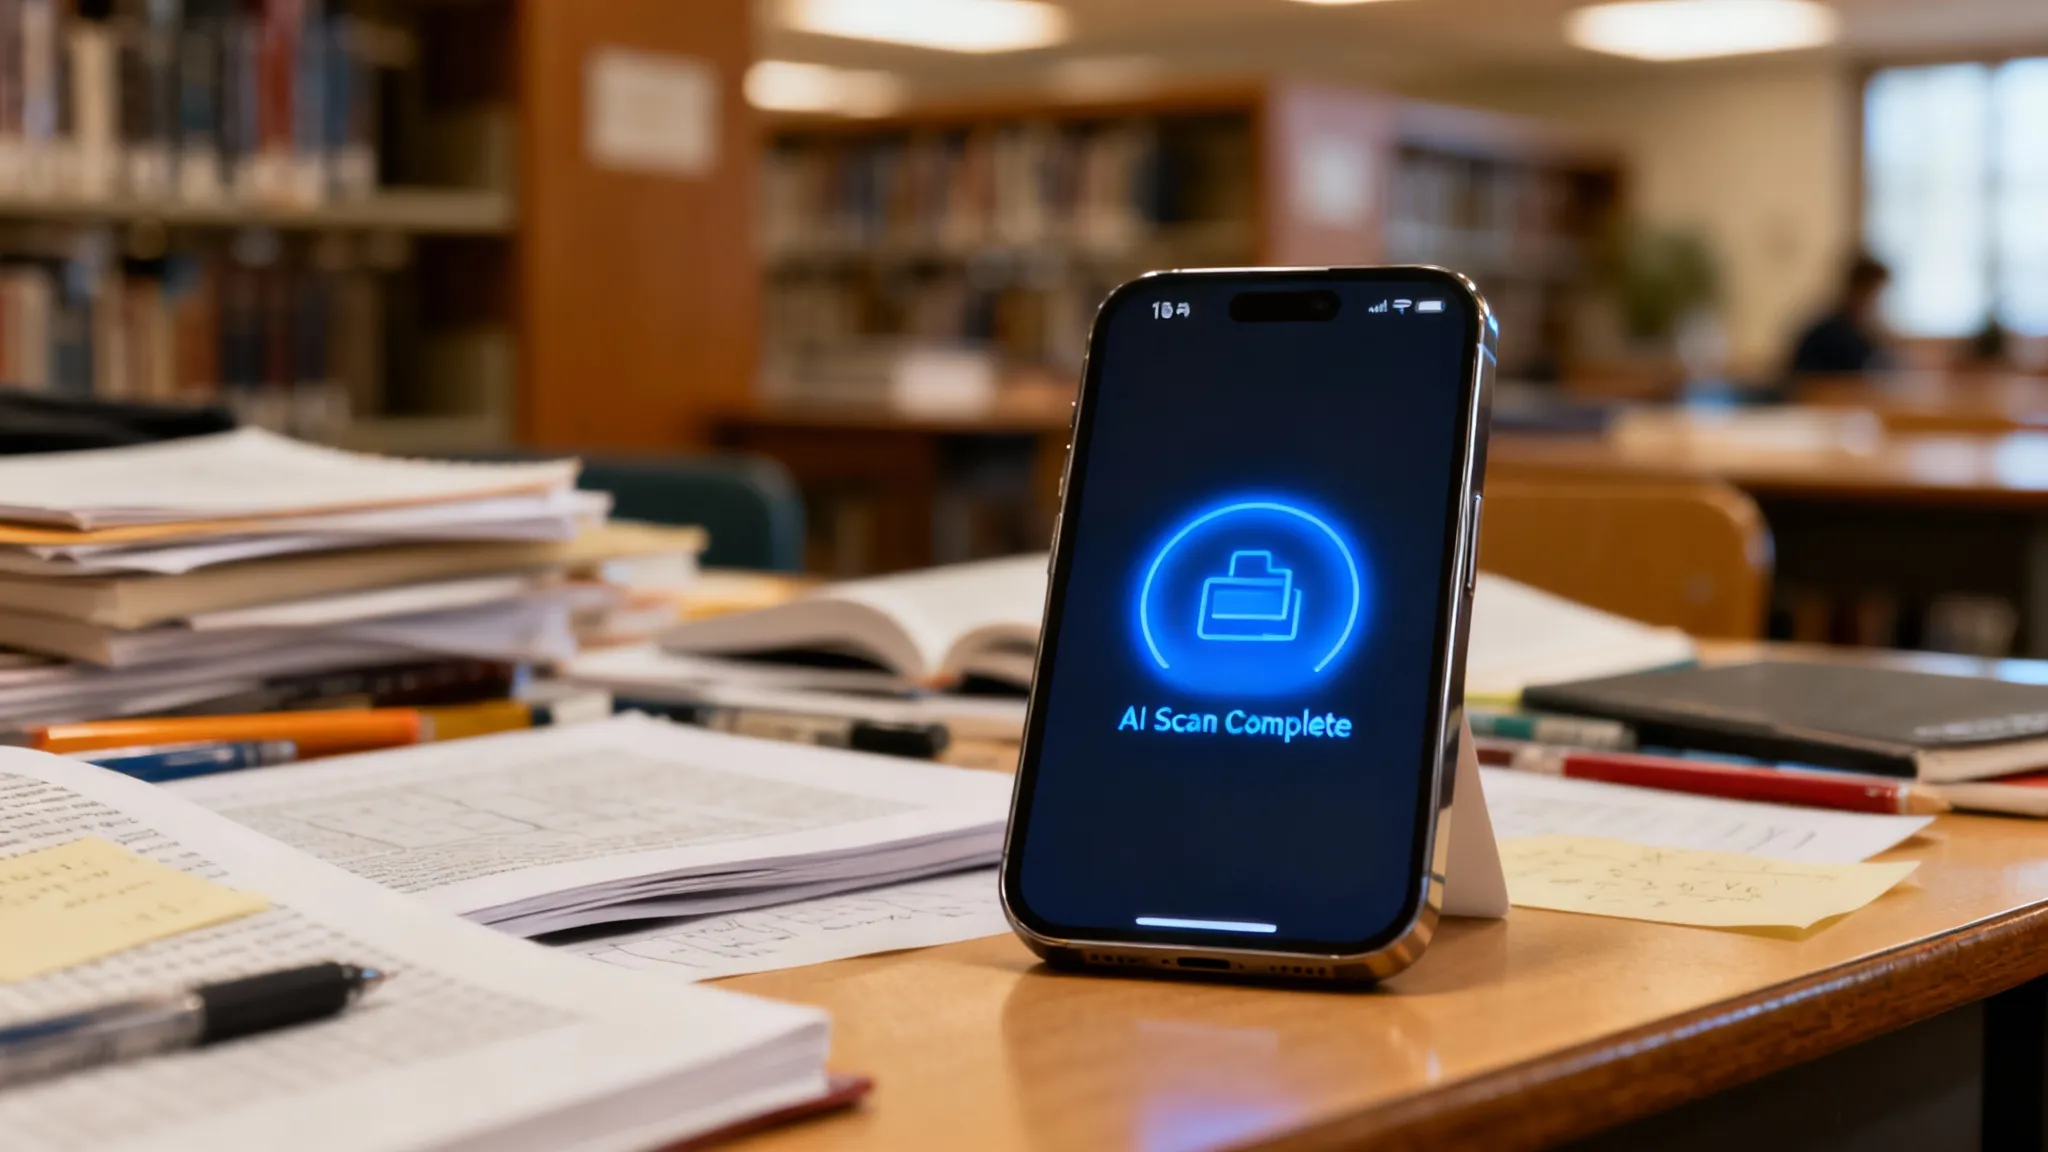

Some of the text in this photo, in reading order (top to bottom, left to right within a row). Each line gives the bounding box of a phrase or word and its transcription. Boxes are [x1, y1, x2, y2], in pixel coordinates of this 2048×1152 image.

[1118, 705, 1353, 743] AI Scan Complete
